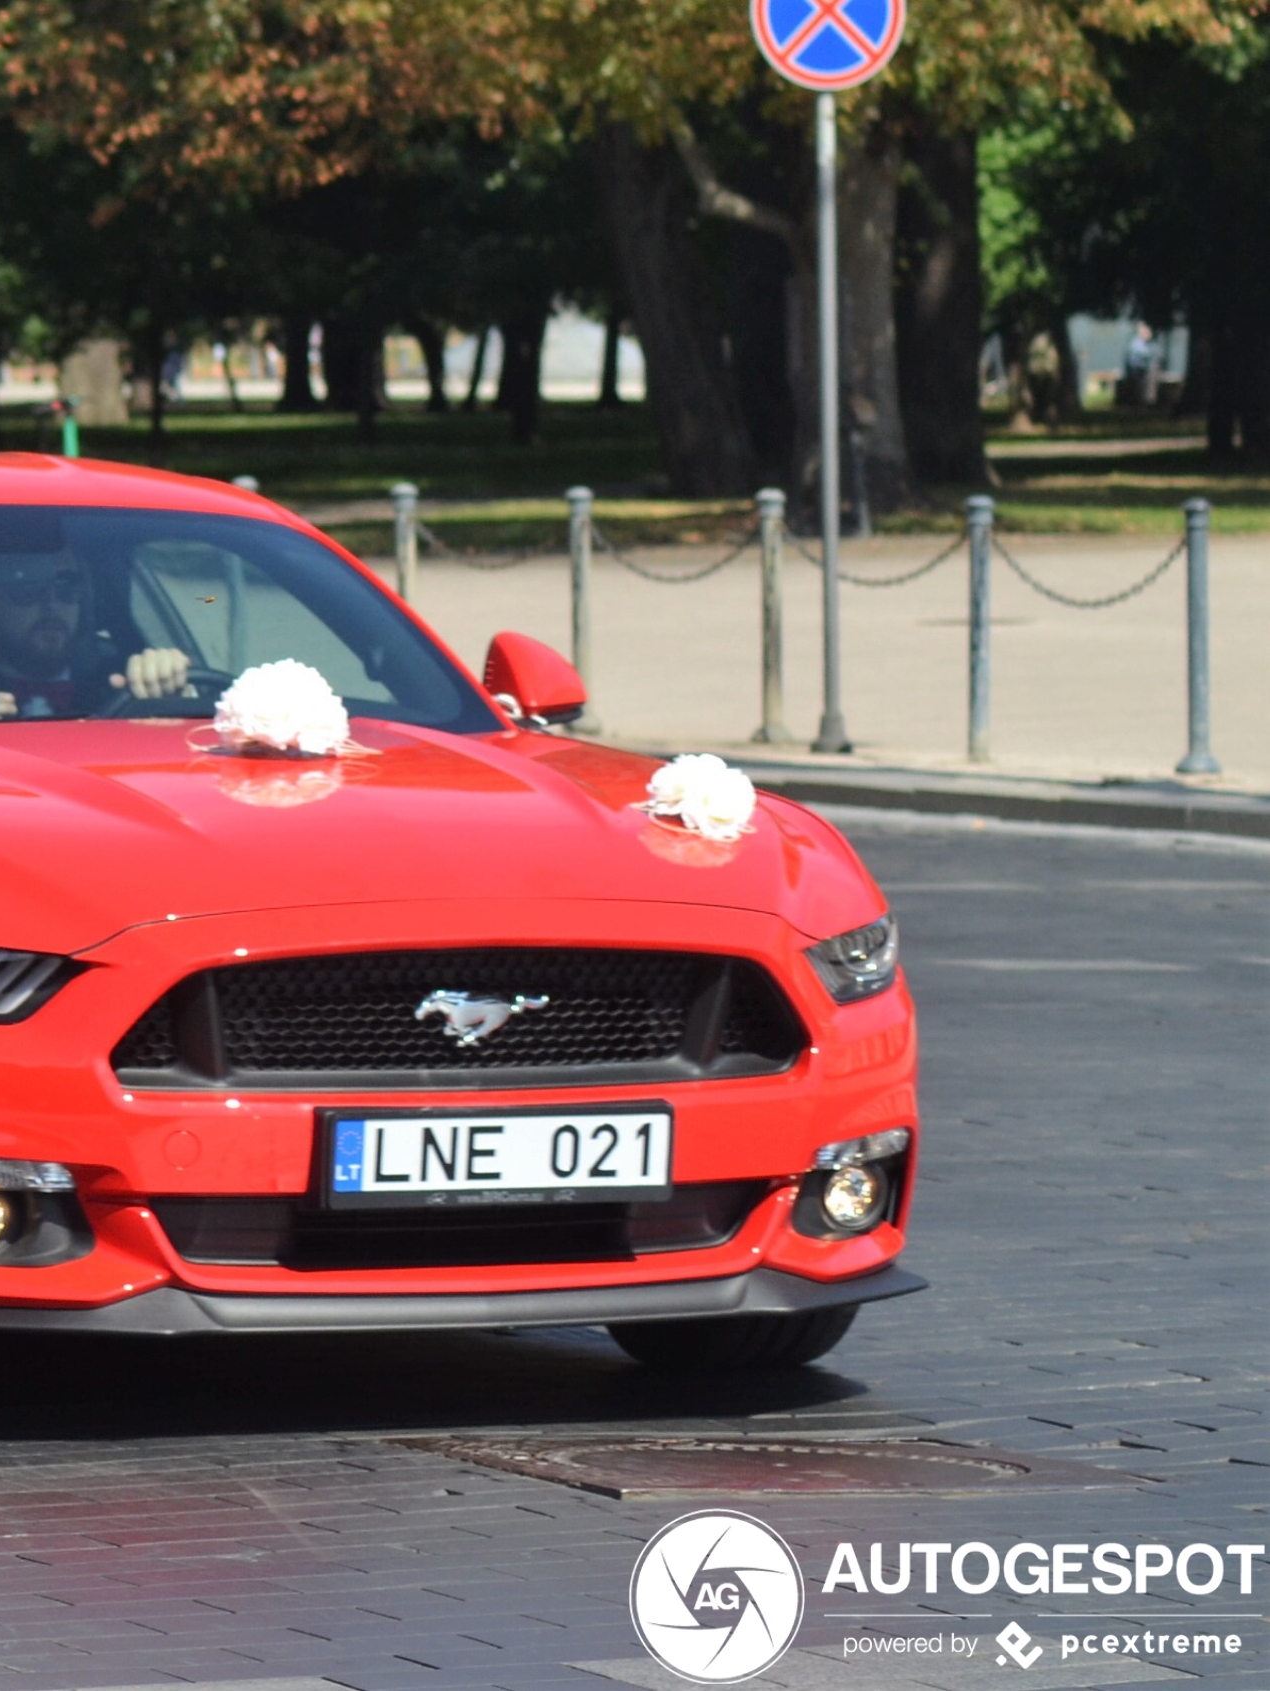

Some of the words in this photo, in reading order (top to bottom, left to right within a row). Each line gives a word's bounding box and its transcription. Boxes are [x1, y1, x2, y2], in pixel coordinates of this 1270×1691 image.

[374, 1126, 504, 1183] LNE
[550, 1123, 652, 1178] 021
[335, 1164, 362, 1181] LT
